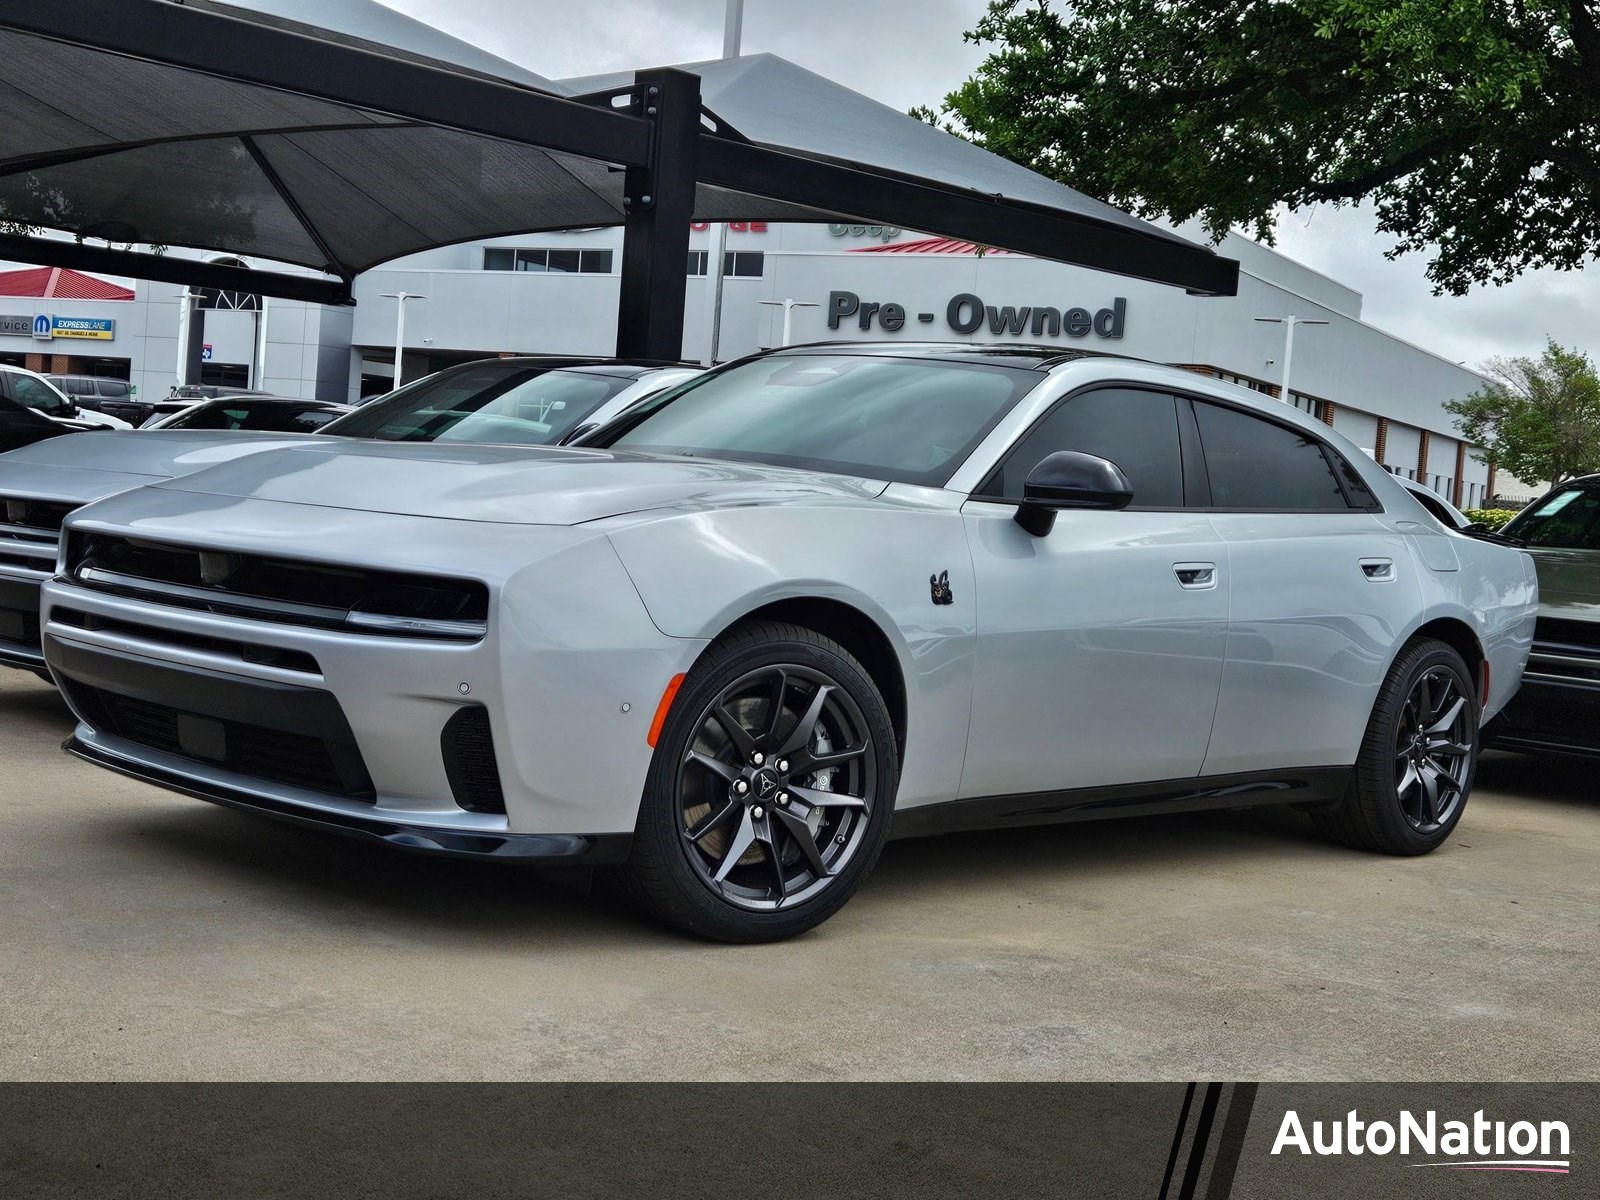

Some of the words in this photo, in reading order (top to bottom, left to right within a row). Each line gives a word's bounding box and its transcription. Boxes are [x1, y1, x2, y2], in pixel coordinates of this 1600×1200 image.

[828, 290, 905, 331] Pre
[917, 313, 934, 322] -
[946, 293, 1127, 338] Owned
